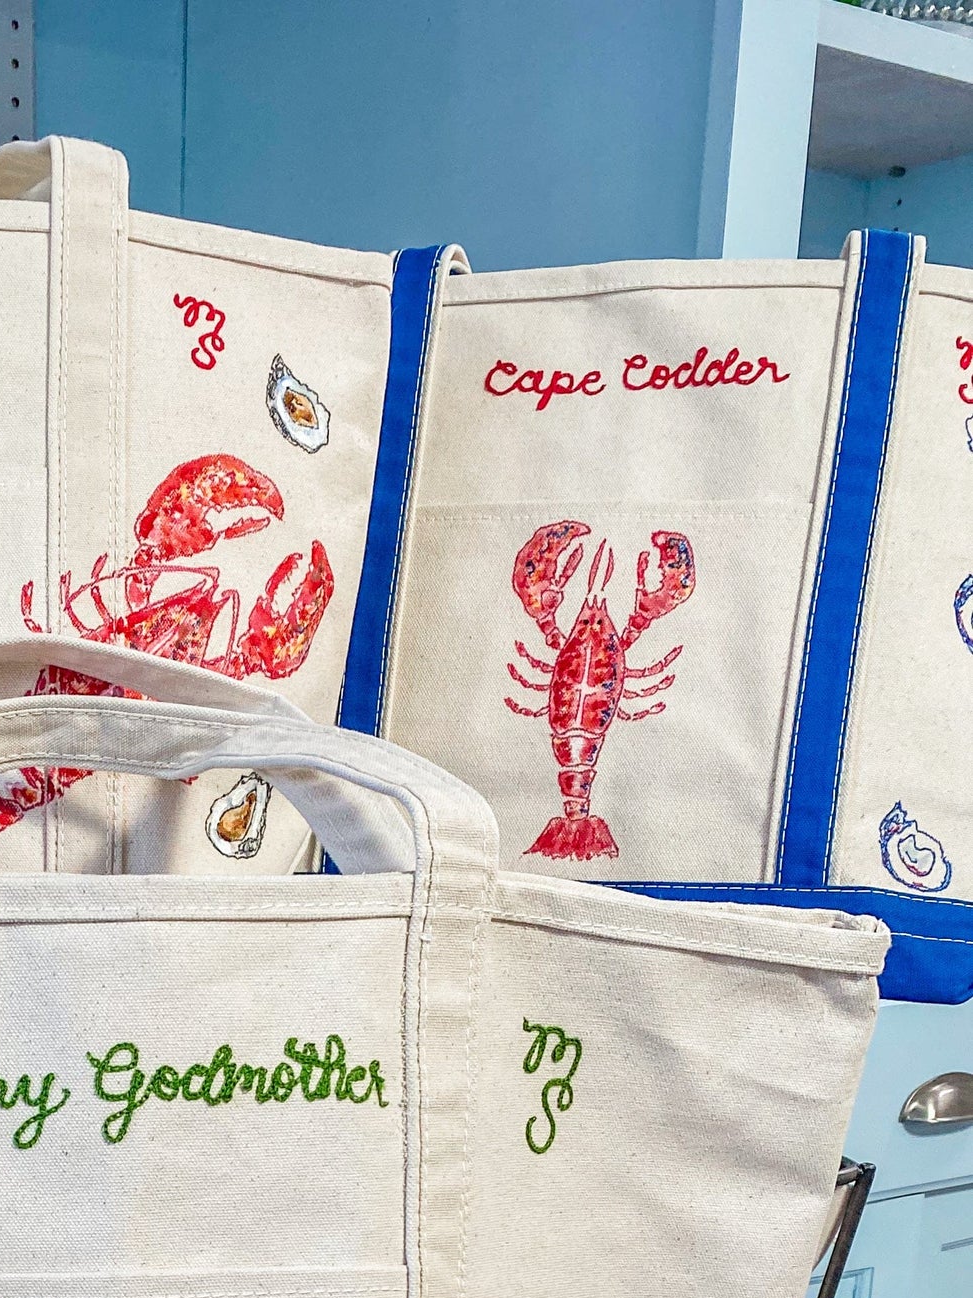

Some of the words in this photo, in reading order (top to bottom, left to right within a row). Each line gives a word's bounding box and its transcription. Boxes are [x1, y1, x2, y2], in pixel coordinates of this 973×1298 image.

[484, 360, 606, 412] Cape
[622, 346, 791, 392] Codder
[86, 1034, 389, 1144] Godmother
